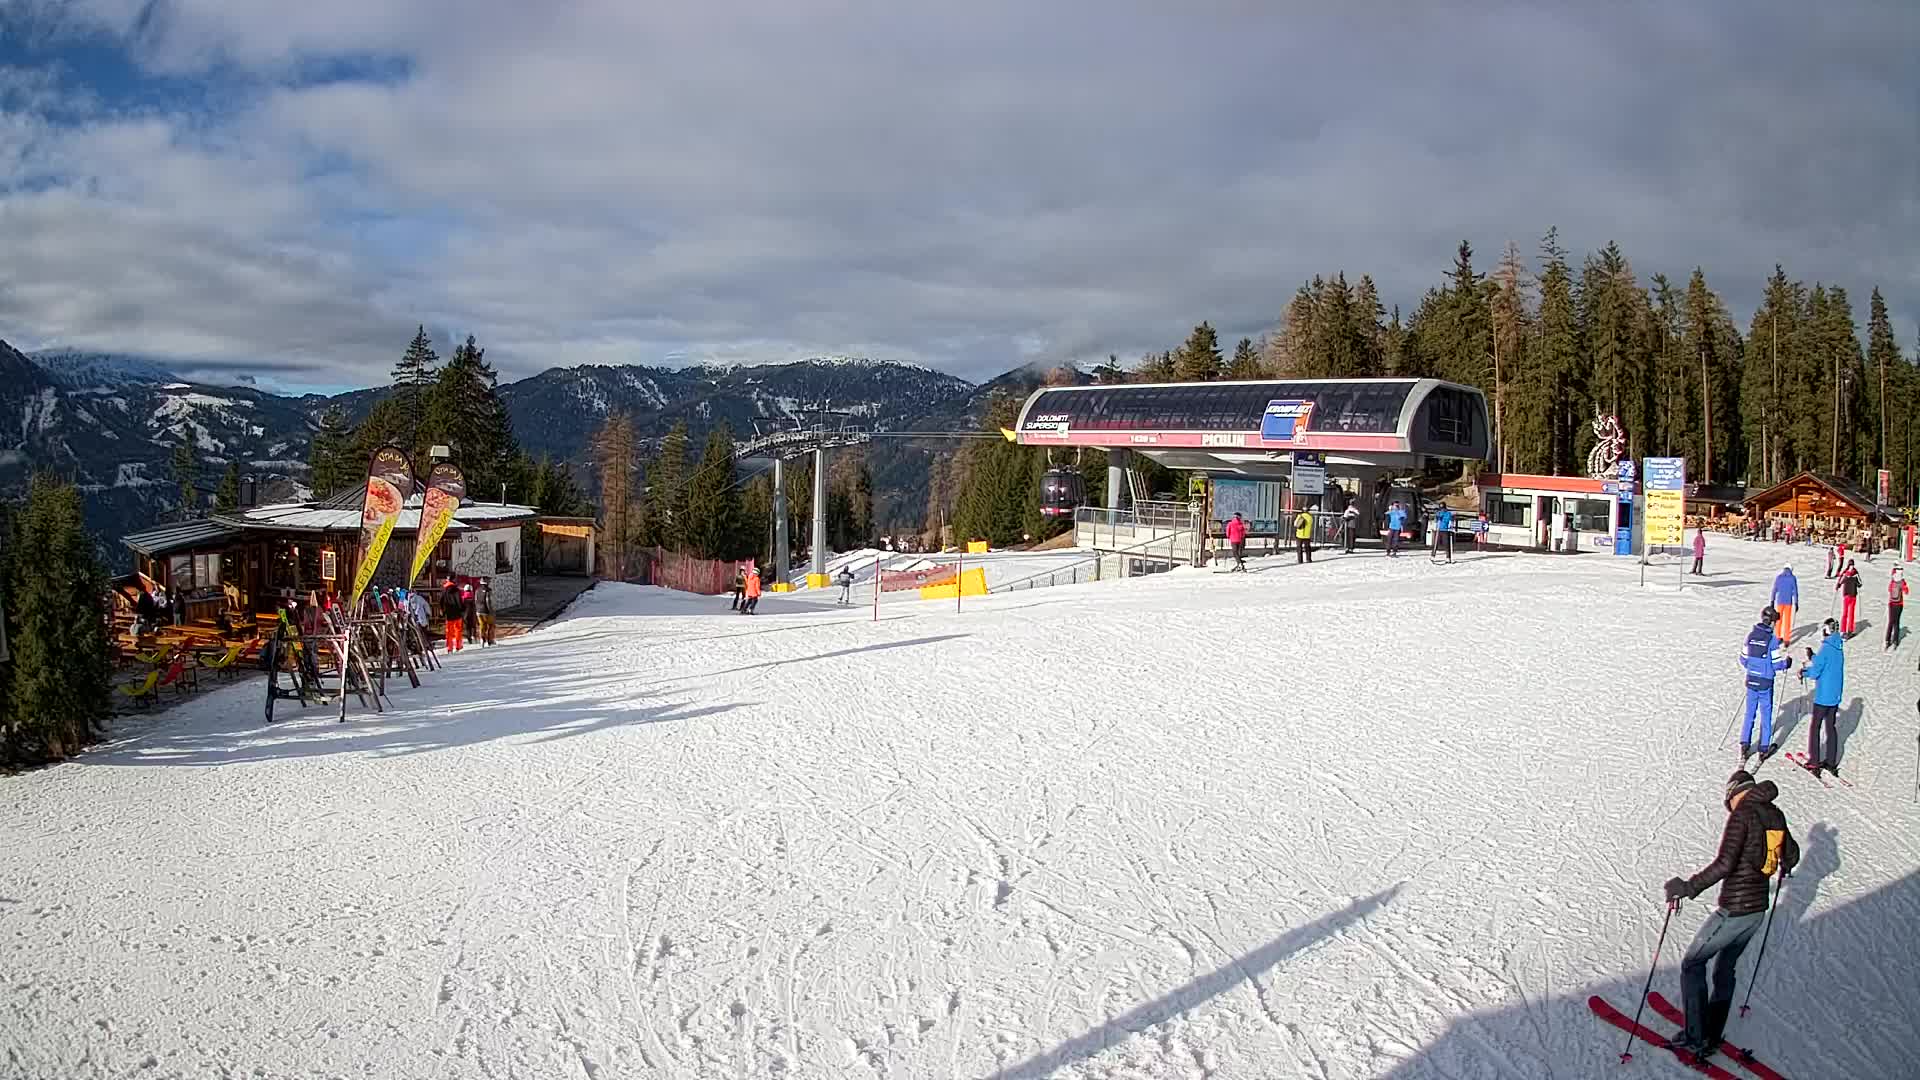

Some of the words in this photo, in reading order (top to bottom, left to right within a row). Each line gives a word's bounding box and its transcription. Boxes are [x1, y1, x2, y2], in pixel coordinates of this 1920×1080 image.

[1036, 414, 1069, 422] DOLOMITI
[1025, 422, 1059, 430] SUPERSKI
[419, 511, 450, 558] PIZZERIA
